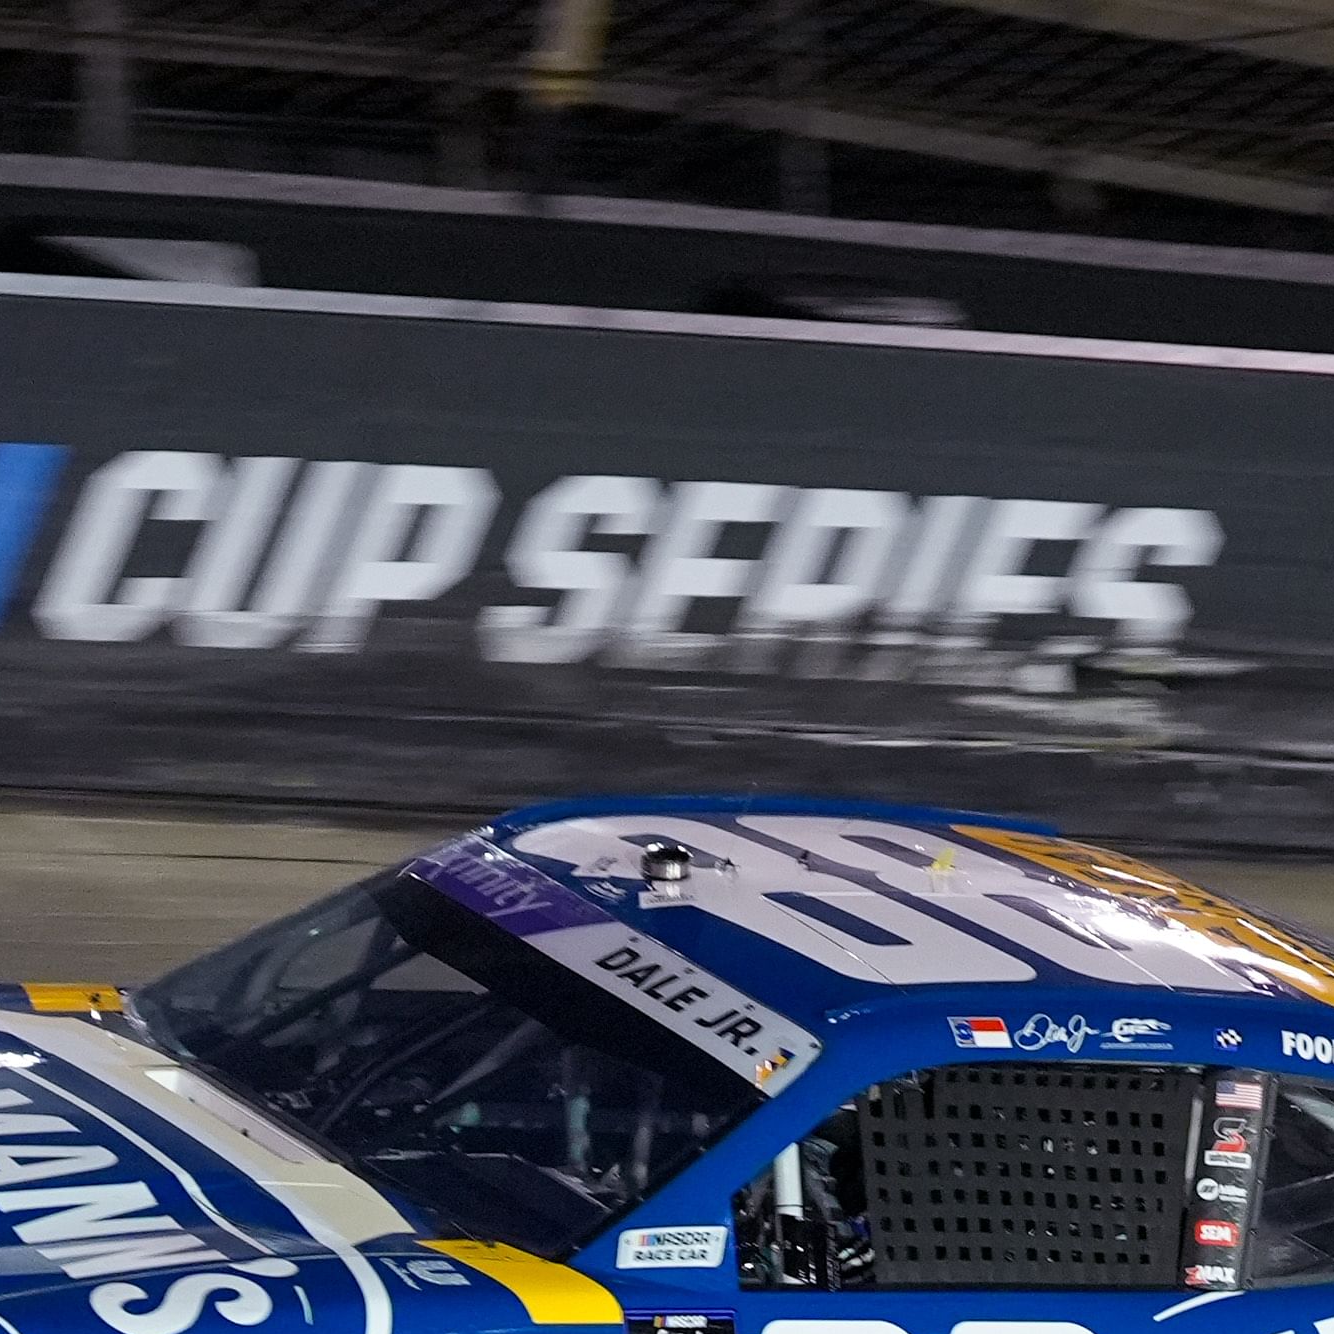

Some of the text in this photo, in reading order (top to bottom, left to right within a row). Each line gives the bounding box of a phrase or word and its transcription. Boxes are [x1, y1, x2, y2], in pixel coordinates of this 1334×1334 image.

[30, 451, 1225, 690] CUP SERIES
[594, 947, 759, 1056] DALE JR.
[634, 1248, 708, 1261] RACE CAR
